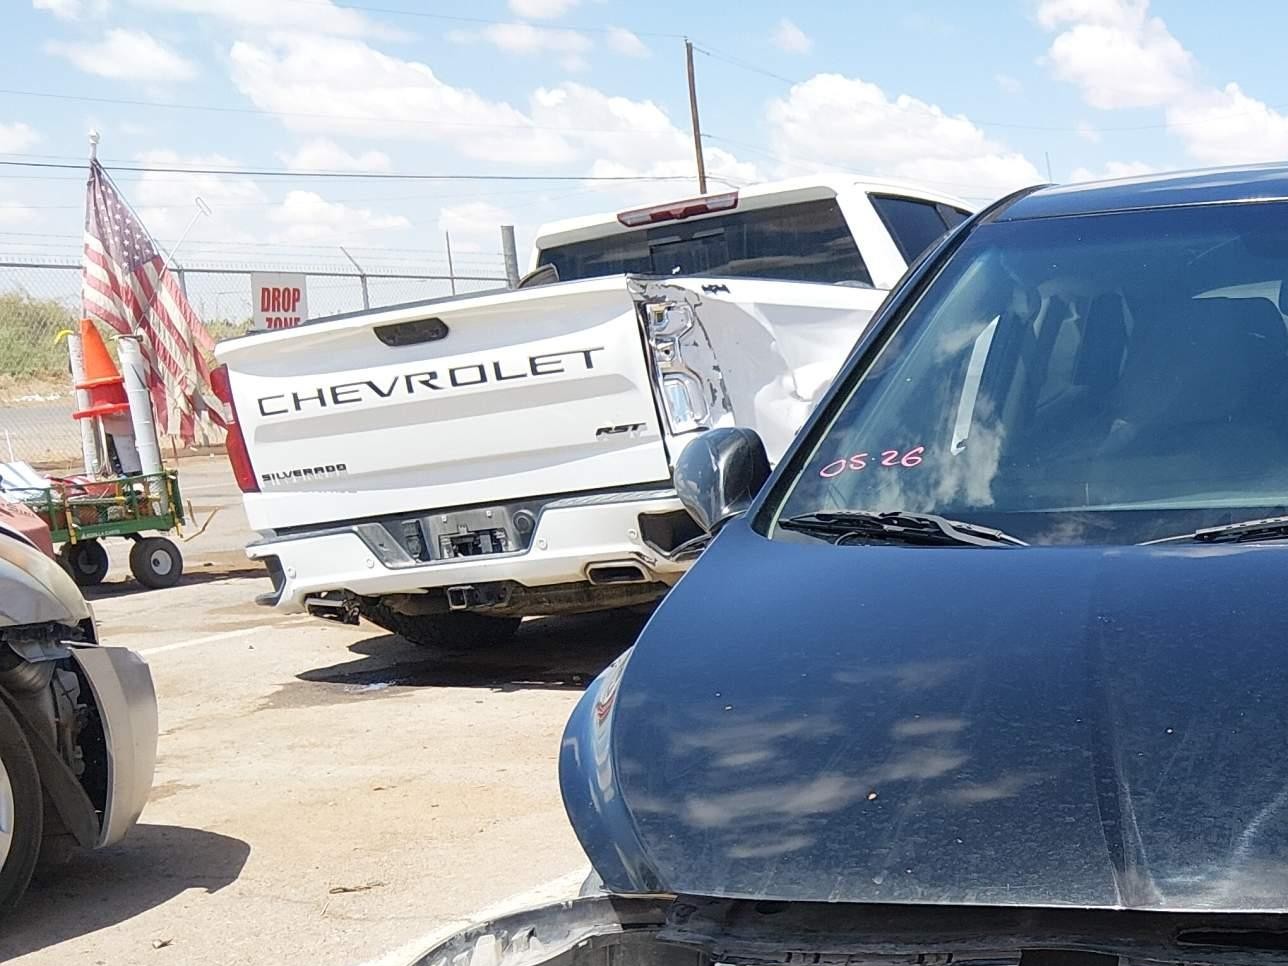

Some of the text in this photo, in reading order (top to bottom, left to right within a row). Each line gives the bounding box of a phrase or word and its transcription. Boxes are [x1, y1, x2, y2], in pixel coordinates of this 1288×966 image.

[261, 287, 301, 312] DROP
[257, 347, 605, 416] CHEVROLET
[596, 422, 647, 436] RST
[261, 463, 347, 482] SILVERADO
